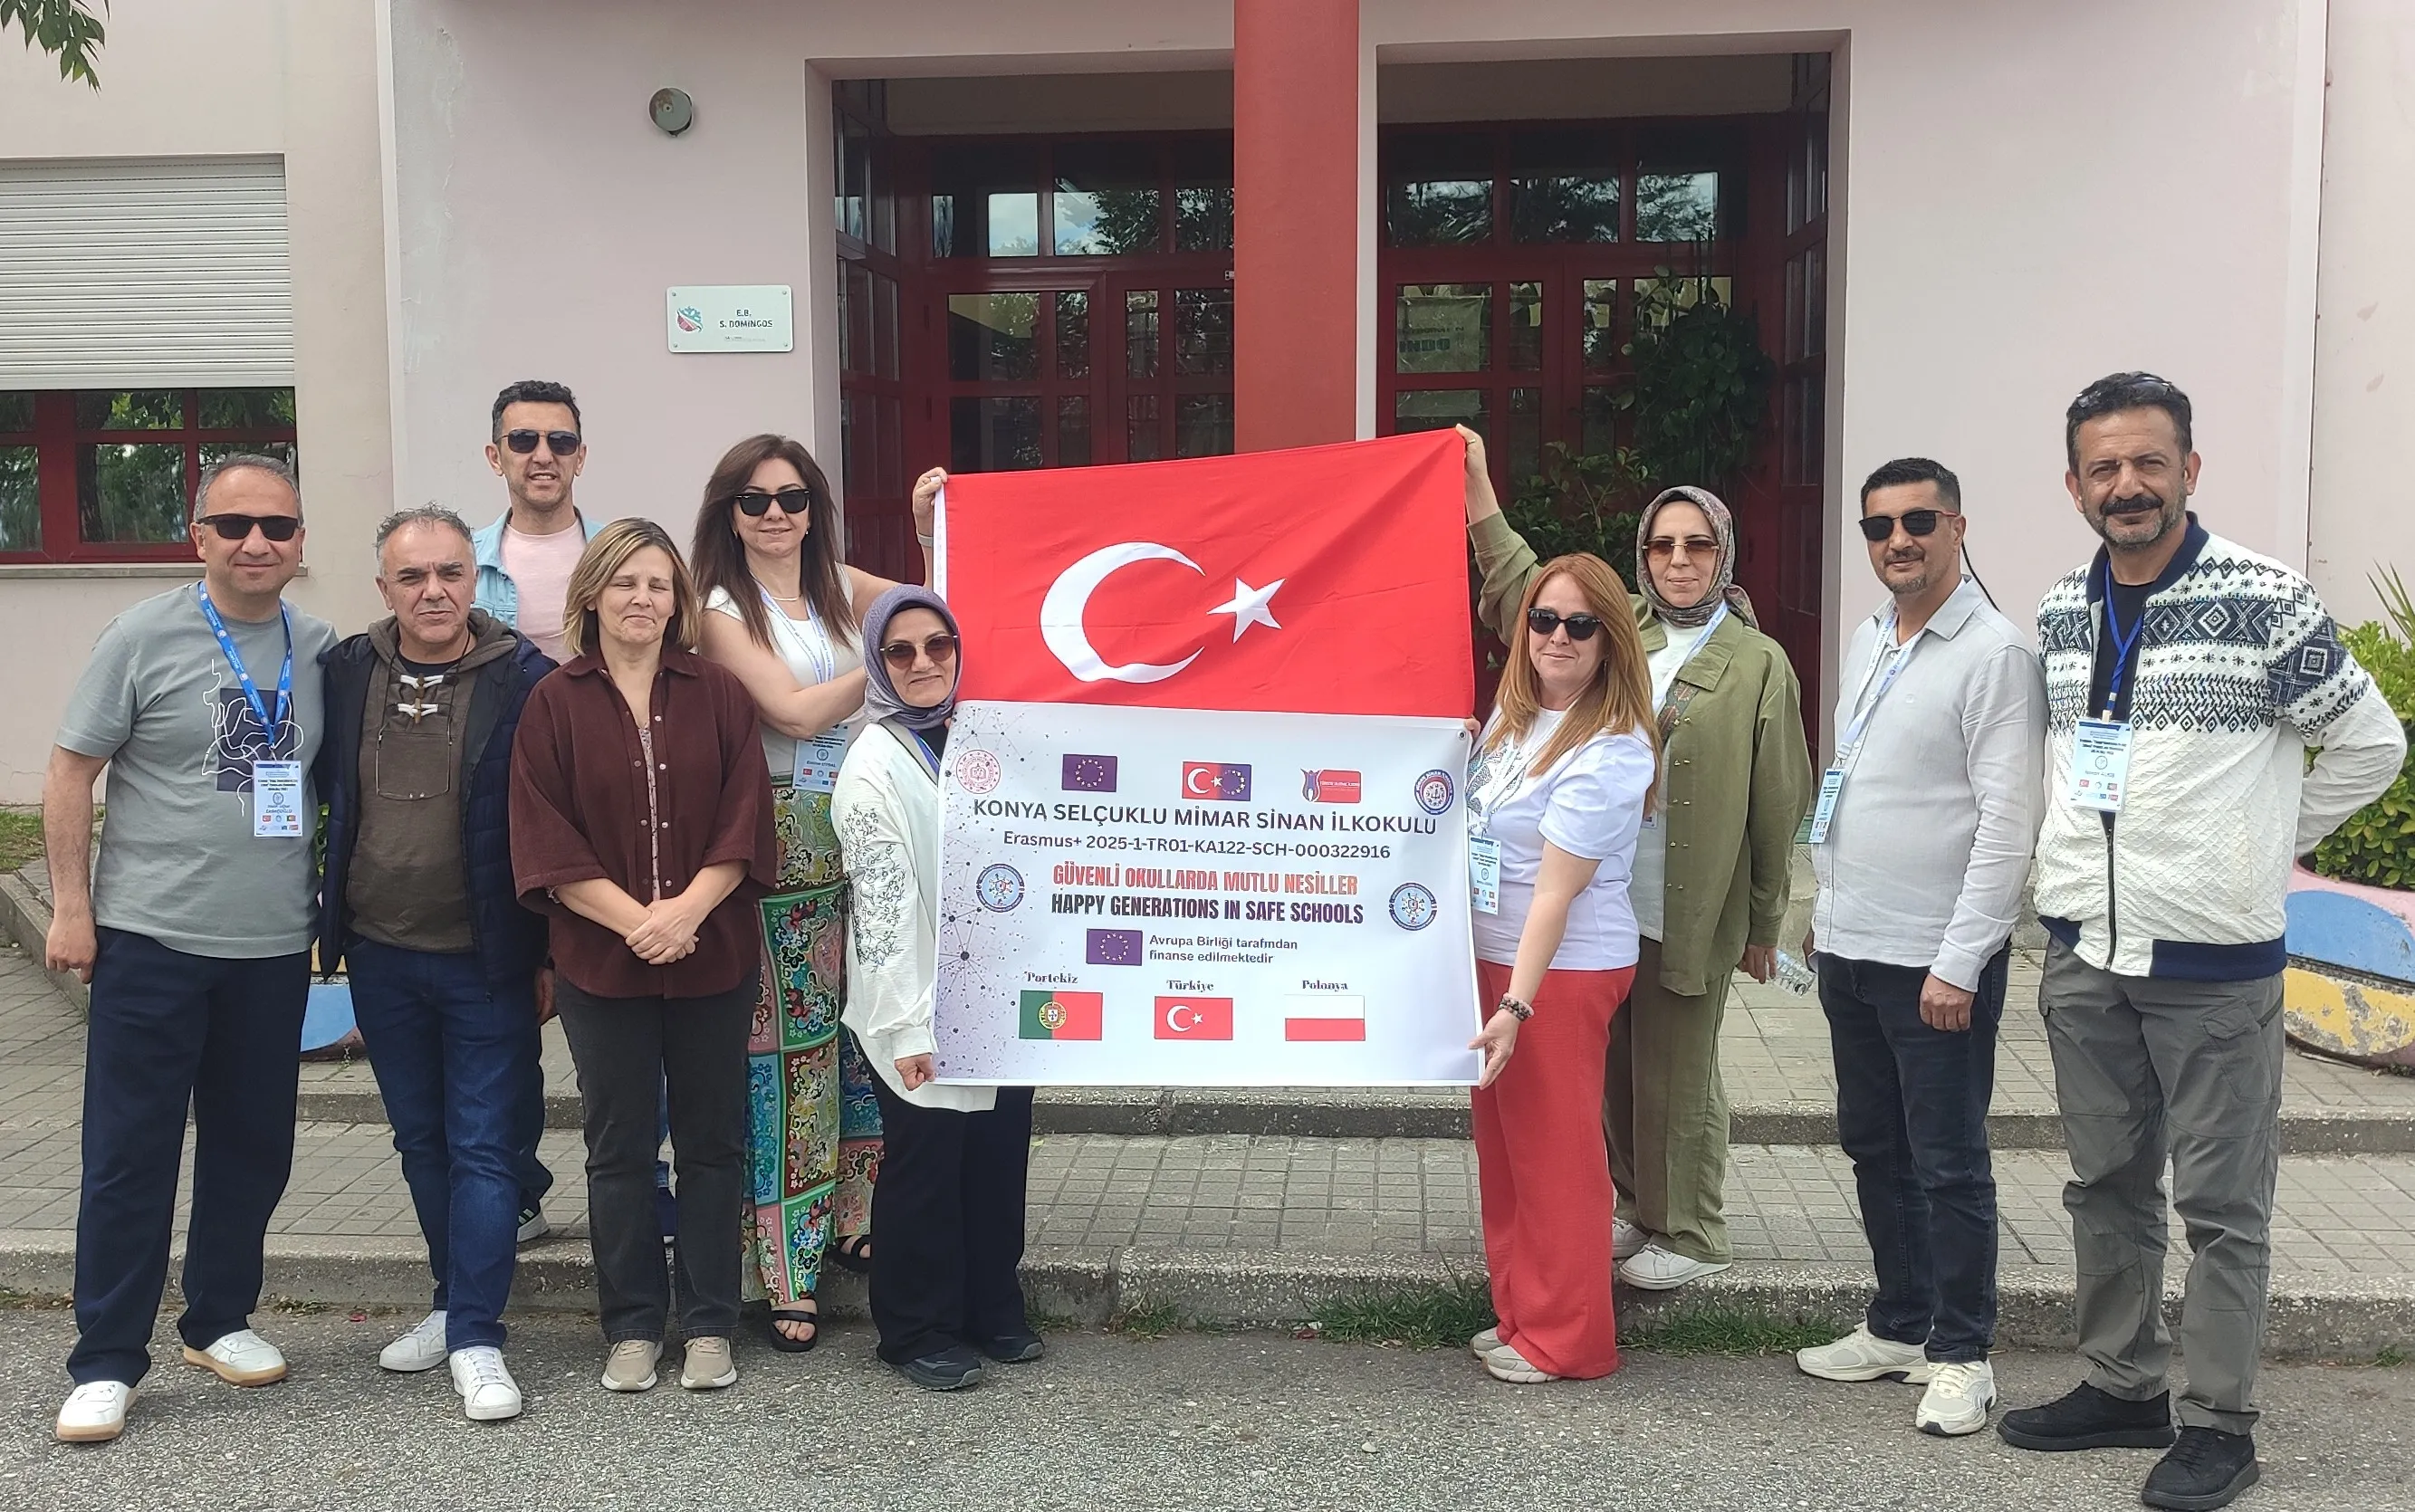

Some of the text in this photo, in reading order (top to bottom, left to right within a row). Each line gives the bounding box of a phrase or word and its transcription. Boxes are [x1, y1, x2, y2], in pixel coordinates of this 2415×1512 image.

[736, 309, 752, 317] E.B.
[729, 320, 773, 328] DOMINGOS
[973, 799, 1436, 835] KONYA SELÇUKLU MİMAR SİNAN İLKOKULU
[1003, 831, 1391, 858] Erasmus+ 2025-1-TR01-KA122-SCH-000322916
[1053, 861, 1358, 895] GÜVENLİ OKULLARDA MUTLU NESİLLER
[1051, 893, 1364, 923] HAPPY GENERATIONS IN SAFE SCHOOLS
[1149, 934, 1193, 948] Avrupa
[1196, 935, 1232, 950] Birliği
[1149, 950, 1274, 963] finanse edilmektedir
[1025, 971, 1078, 983] Portekiz
[1166, 979, 1214, 992] Türkiye
[1301, 979, 1348, 992] Polonya
